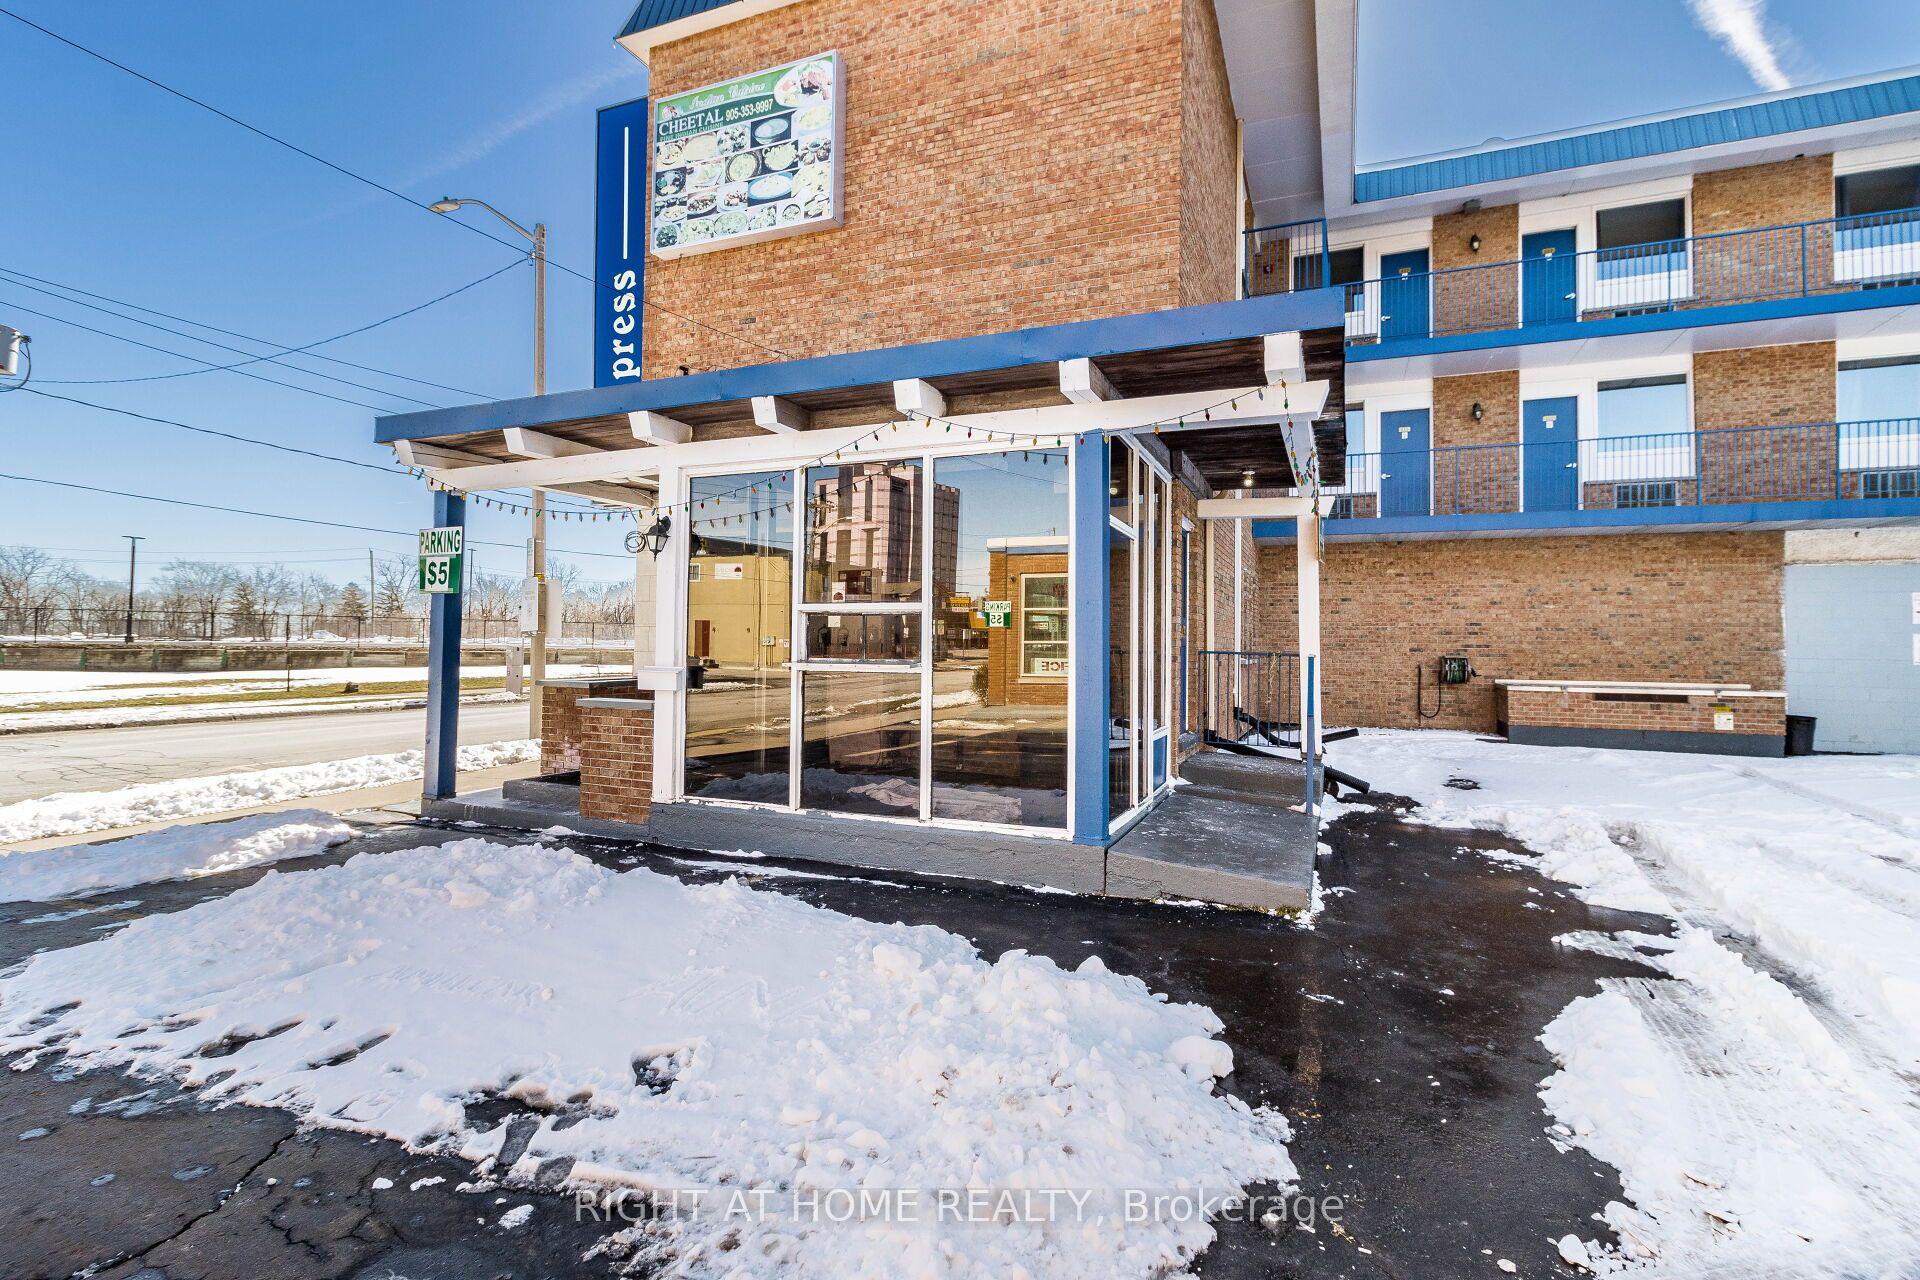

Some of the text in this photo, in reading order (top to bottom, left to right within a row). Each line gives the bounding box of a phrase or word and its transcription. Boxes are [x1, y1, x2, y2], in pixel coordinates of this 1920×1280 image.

[659, 110, 723, 136] CHEETAL
[726, 99, 774, 122] 905-353-9997
[613, 270, 640, 380] press
[420, 530, 460, 553] PARKING
[427, 561, 448, 587] $5
